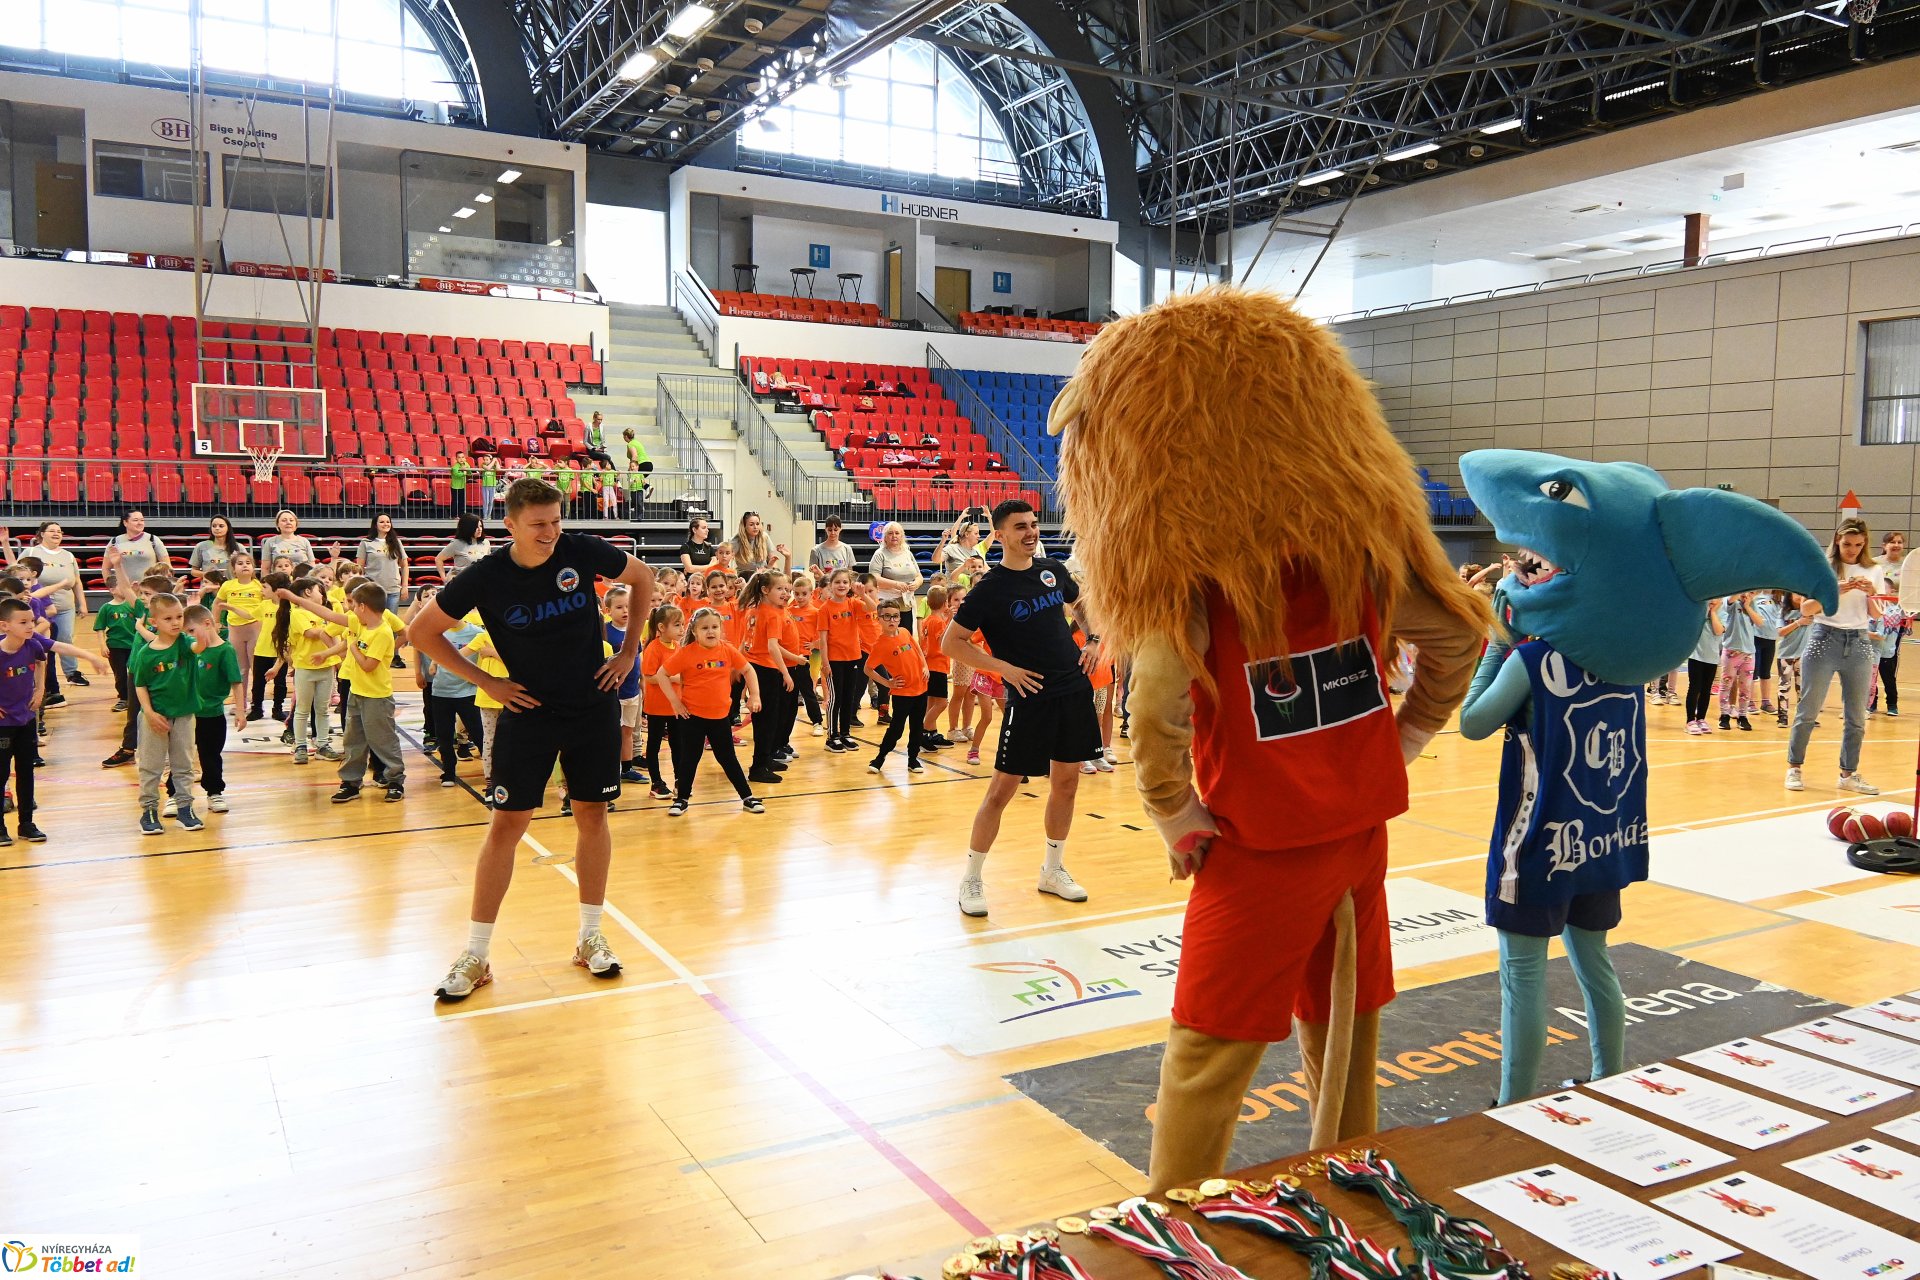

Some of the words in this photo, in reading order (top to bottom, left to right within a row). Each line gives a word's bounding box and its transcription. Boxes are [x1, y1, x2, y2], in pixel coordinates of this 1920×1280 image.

[209, 123, 233, 134] Bige
[237, 126, 278, 140] Holding
[222, 136, 265, 149] Csoport
[901, 203, 958, 221] HÜBNER
[201, 441, 209, 451] 5
[535, 592, 587, 622] JAKO
[1032, 590, 1065, 613] JAKO
[1322, 669, 1369, 692] MKOSZ
[1540, 649, 1603, 698] Co
[601, 784, 618, 794] JAKO
[1101, 934, 1182, 960] NYÍ
